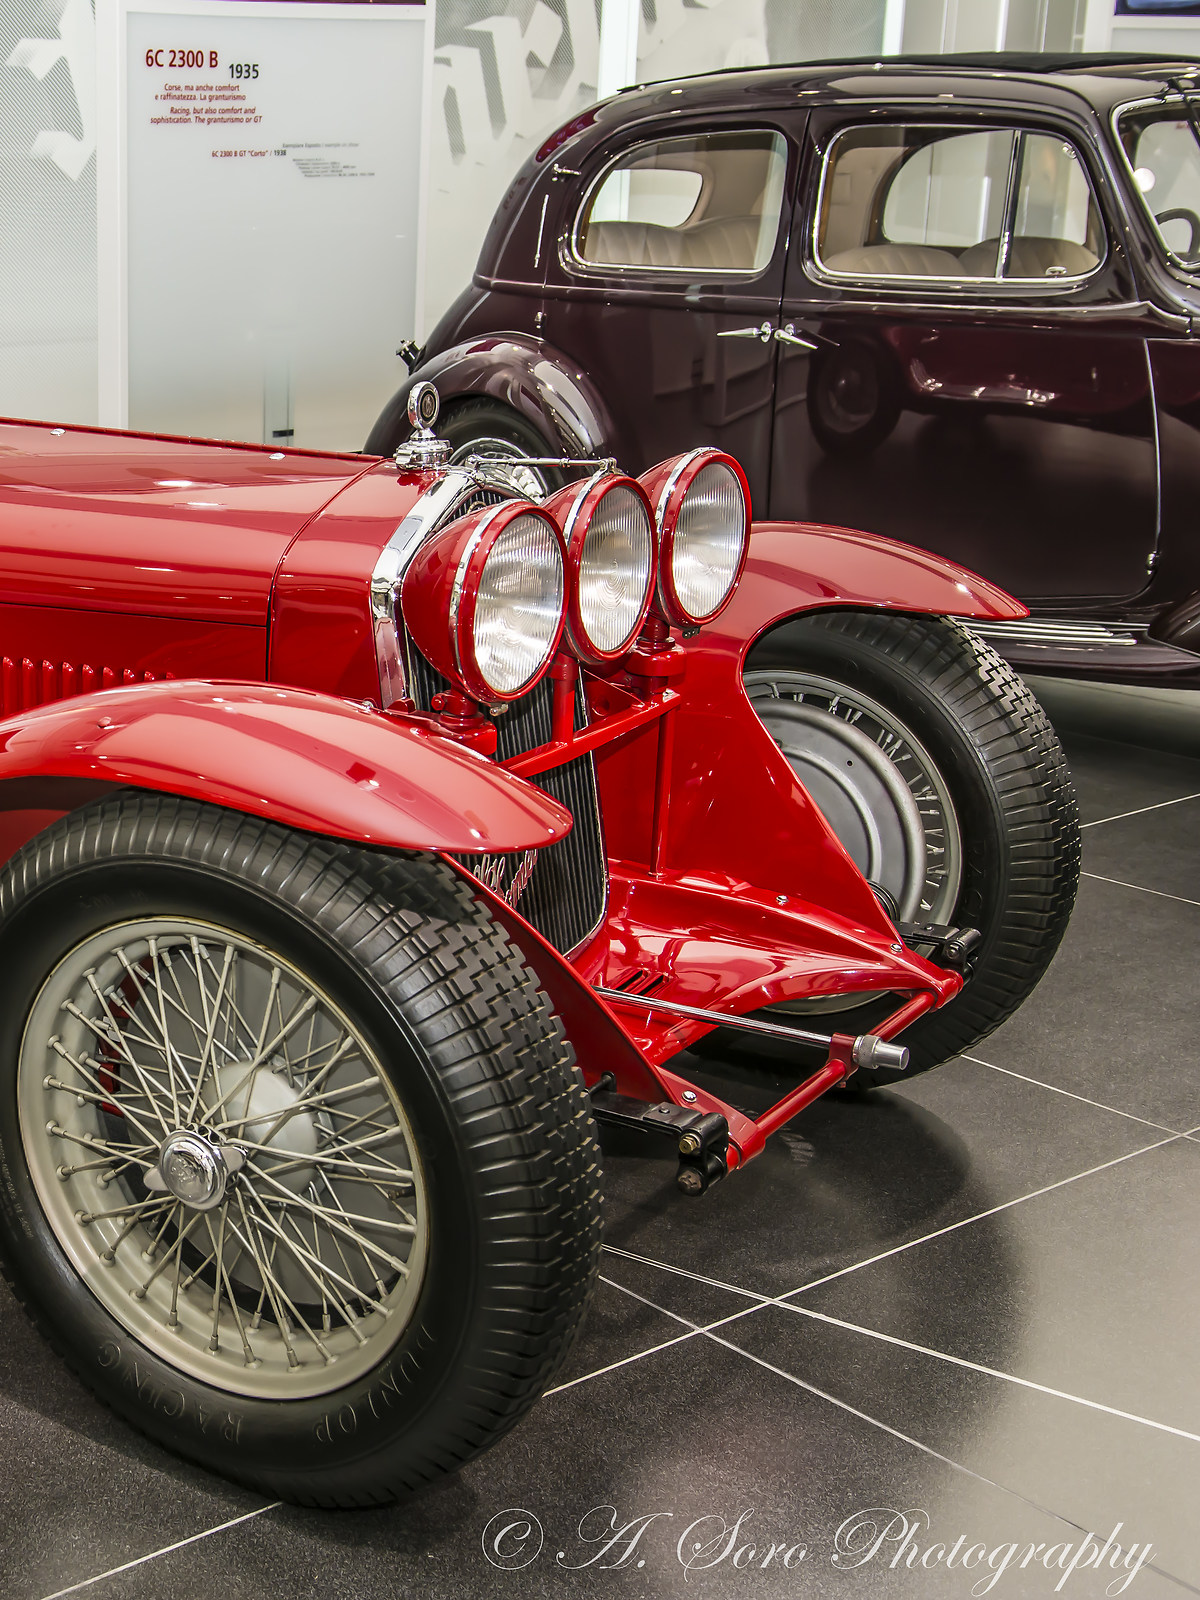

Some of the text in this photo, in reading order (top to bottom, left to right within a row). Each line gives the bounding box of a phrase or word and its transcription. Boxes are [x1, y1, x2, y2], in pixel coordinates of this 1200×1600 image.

[145, 49, 218, 68] 6C 2300 B
[229, 63, 259, 79] 1935
[164, 83, 182, 92] Corse,
[208, 93, 246, 102] granturismo
[170, 106, 191, 116] Racing,
[218, 106, 242, 114] comfort
[150, 116, 192, 125] sophistication.
[207, 116, 244, 125] granturismo
[253, 115, 262, 123] GT
